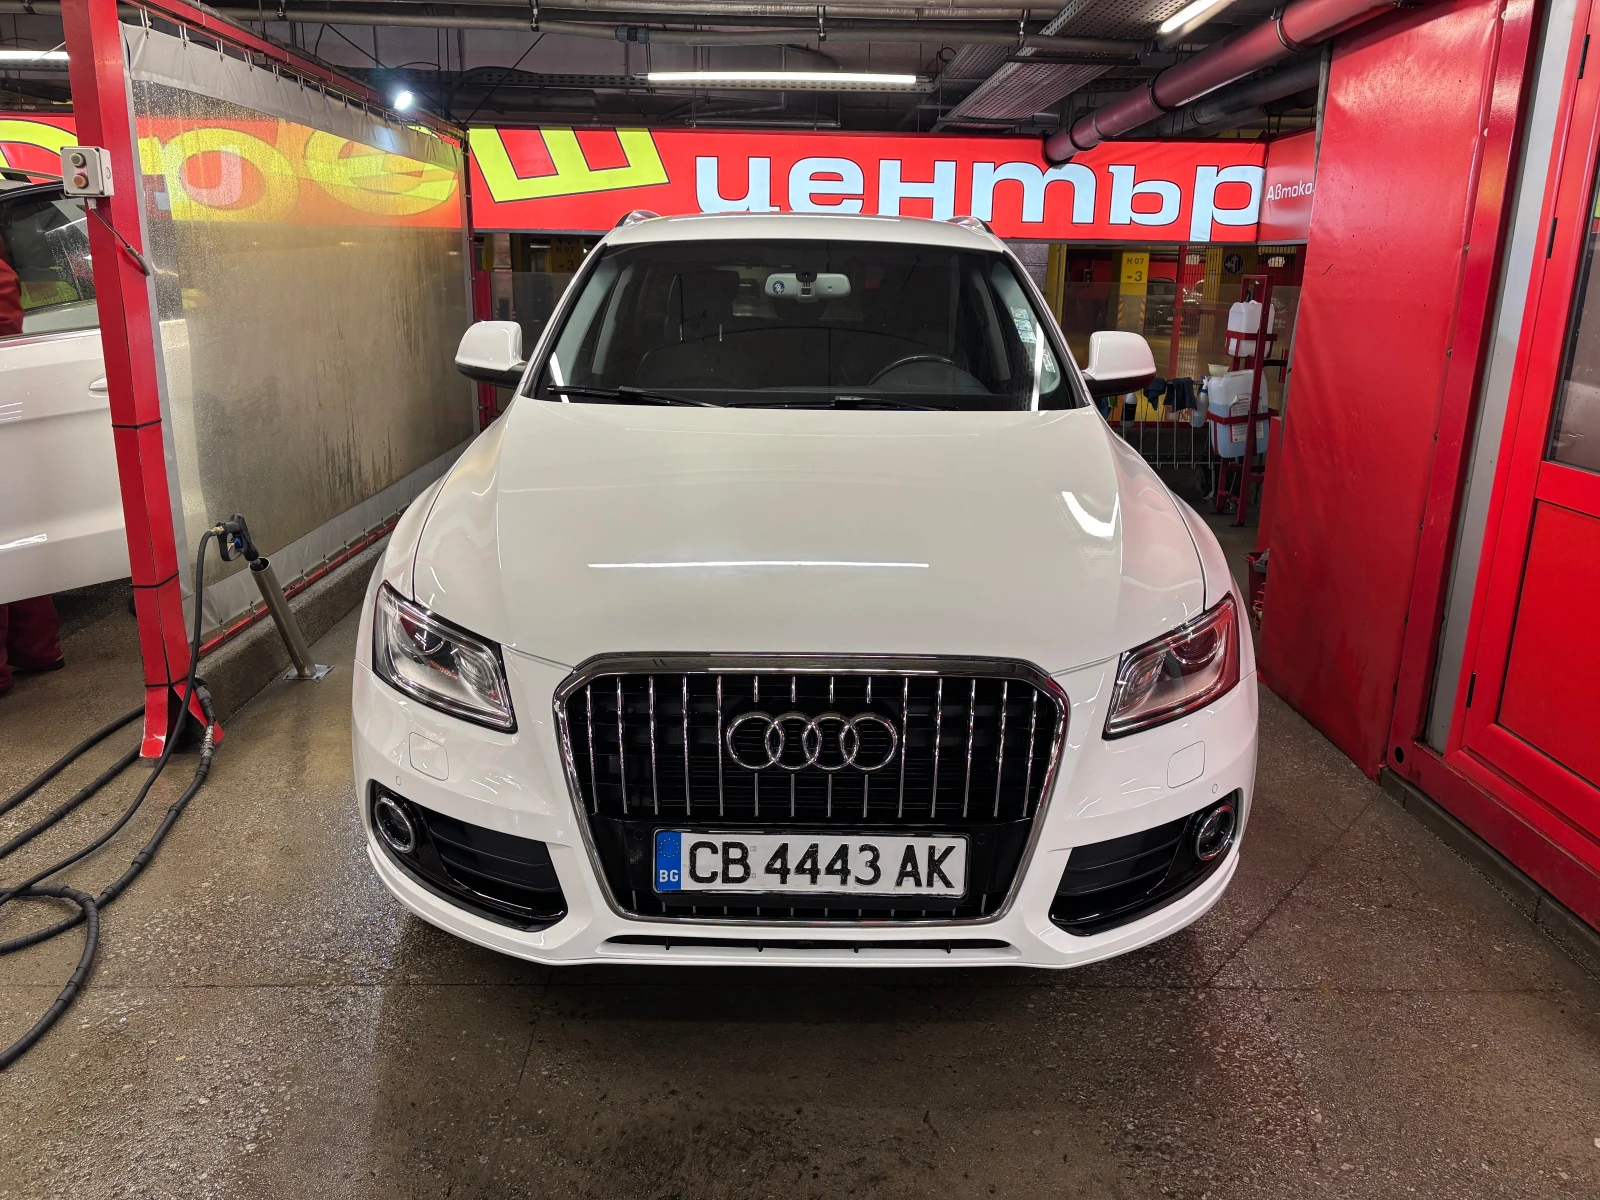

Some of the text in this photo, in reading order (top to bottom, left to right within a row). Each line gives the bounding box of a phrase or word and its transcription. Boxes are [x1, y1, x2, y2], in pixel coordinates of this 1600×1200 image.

[695, 155, 1265, 242] център
[1134, 257, 1145, 265] 07
[659, 869, 679, 883] BG
[688, 840, 957, 888] CB 4443 AK
